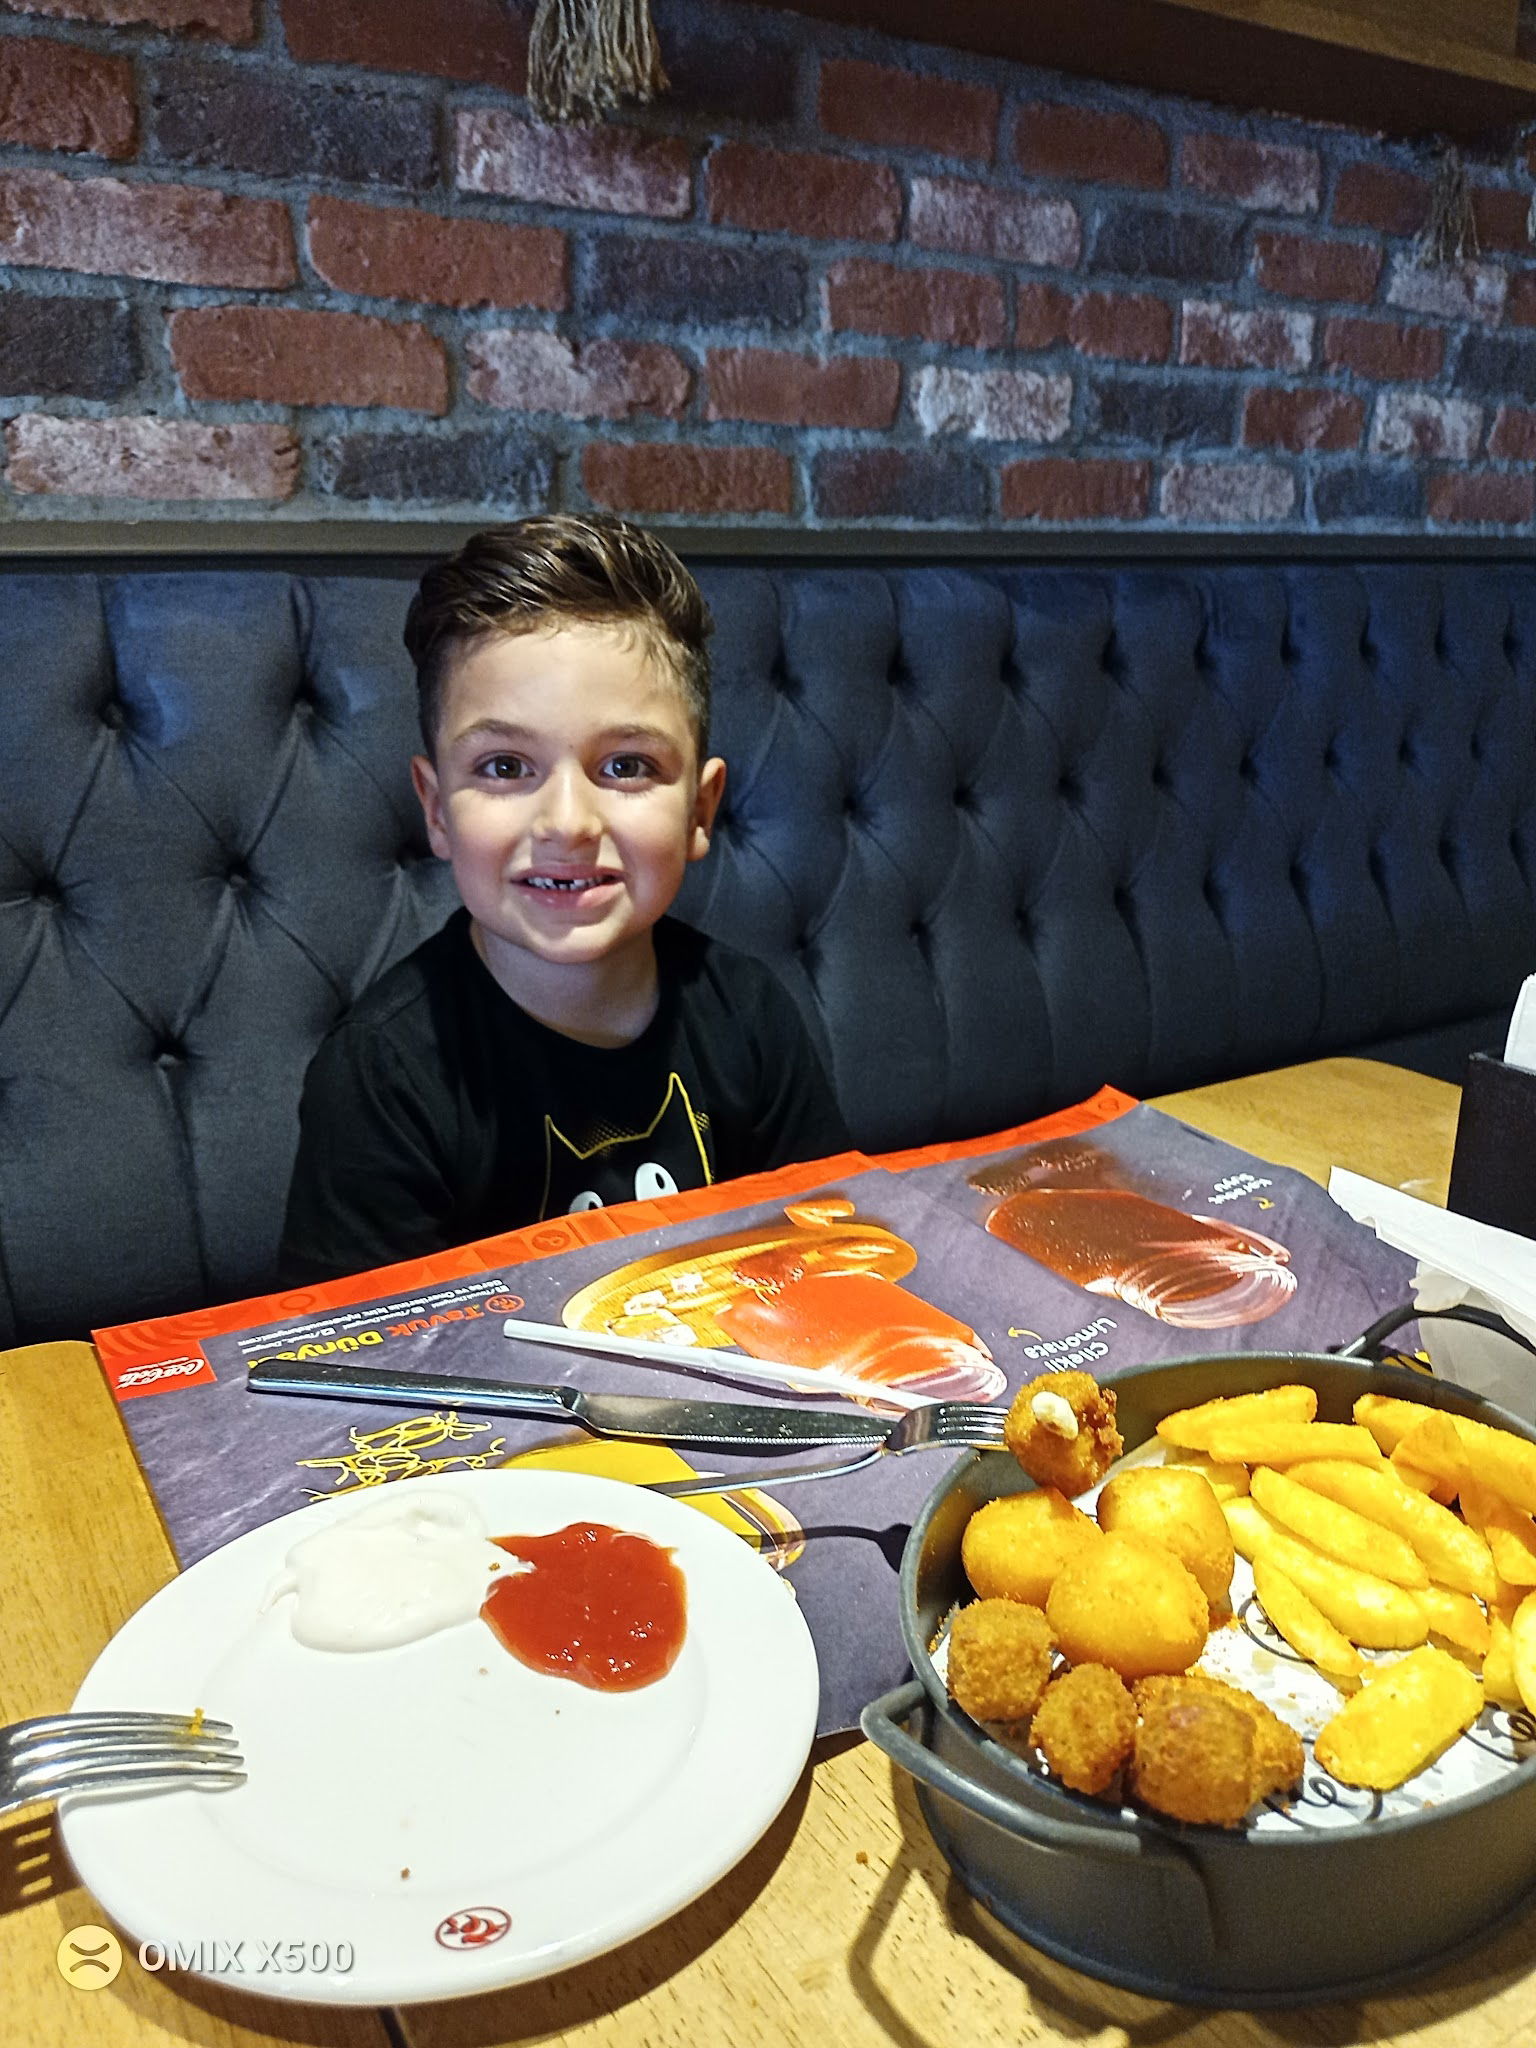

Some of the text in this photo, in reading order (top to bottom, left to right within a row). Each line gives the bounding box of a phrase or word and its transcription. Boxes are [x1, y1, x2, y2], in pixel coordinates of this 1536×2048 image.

[246, 1304, 485, 1369] Tavuk Dünya
[1023, 1316, 1118, 1359] Limonata
